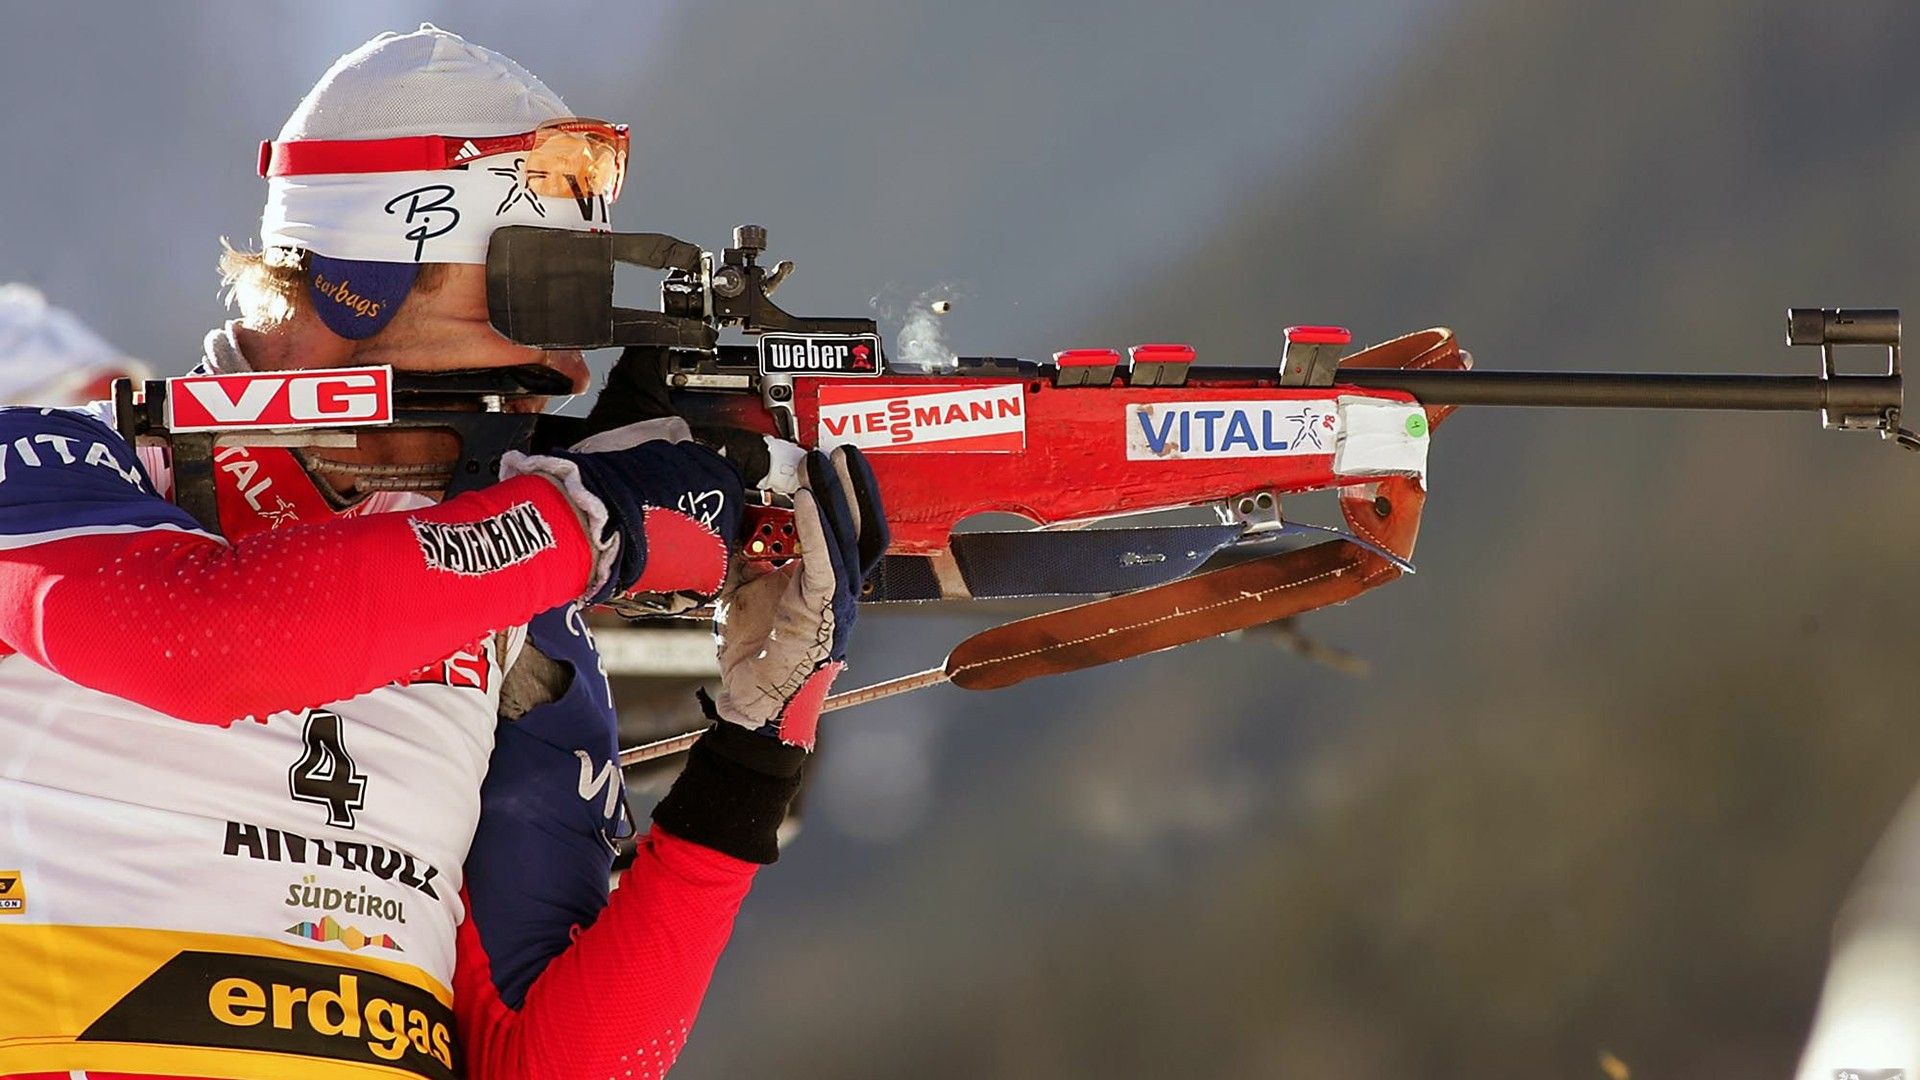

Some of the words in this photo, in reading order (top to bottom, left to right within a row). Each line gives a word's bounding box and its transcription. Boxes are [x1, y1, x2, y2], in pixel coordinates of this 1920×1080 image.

[315, 274, 381, 317] earbags
[770, 338, 848, 369] weber
[183, 375, 379, 422] VG
[822, 397, 1021, 443] VIESSMANN
[1137, 409, 1288, 453] VITAL
[288, 708, 368, 830] 4
[208, 975, 452, 1071] erdgas
